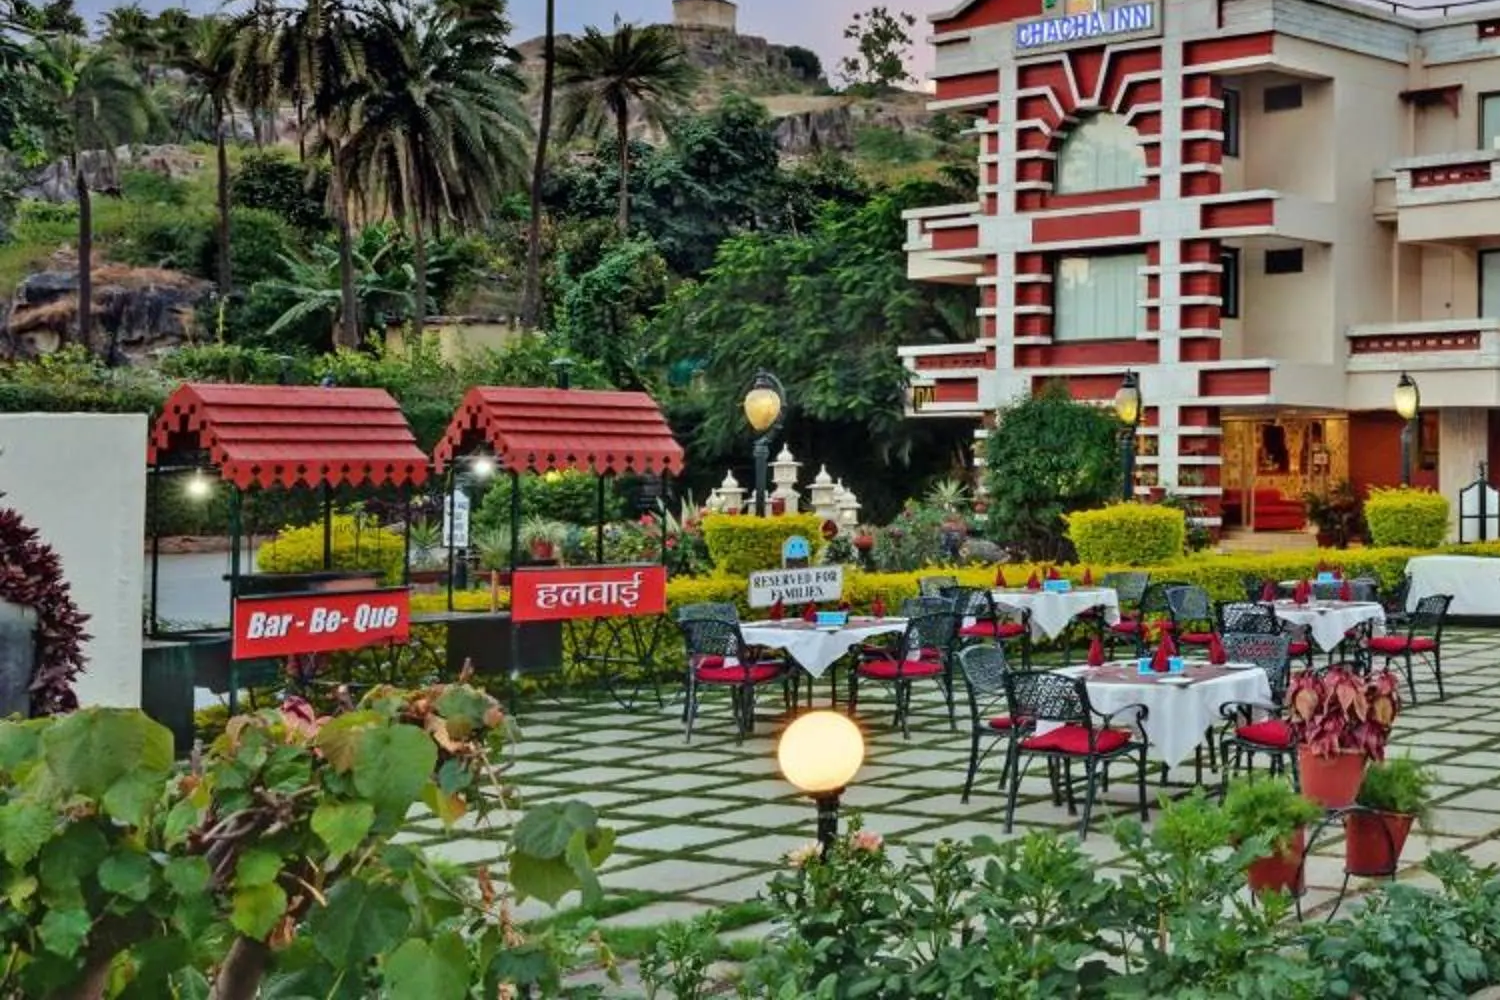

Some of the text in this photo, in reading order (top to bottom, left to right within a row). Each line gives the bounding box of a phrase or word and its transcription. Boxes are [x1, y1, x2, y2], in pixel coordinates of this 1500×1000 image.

[1017, 3, 1152, 47] CHACHA INN
[535, 571, 643, 608] हलवाई
[753, 570, 837, 587] RESERVED FOR
[247, 612, 292, 638] Bar
[353, 604, 398, 632] Que
